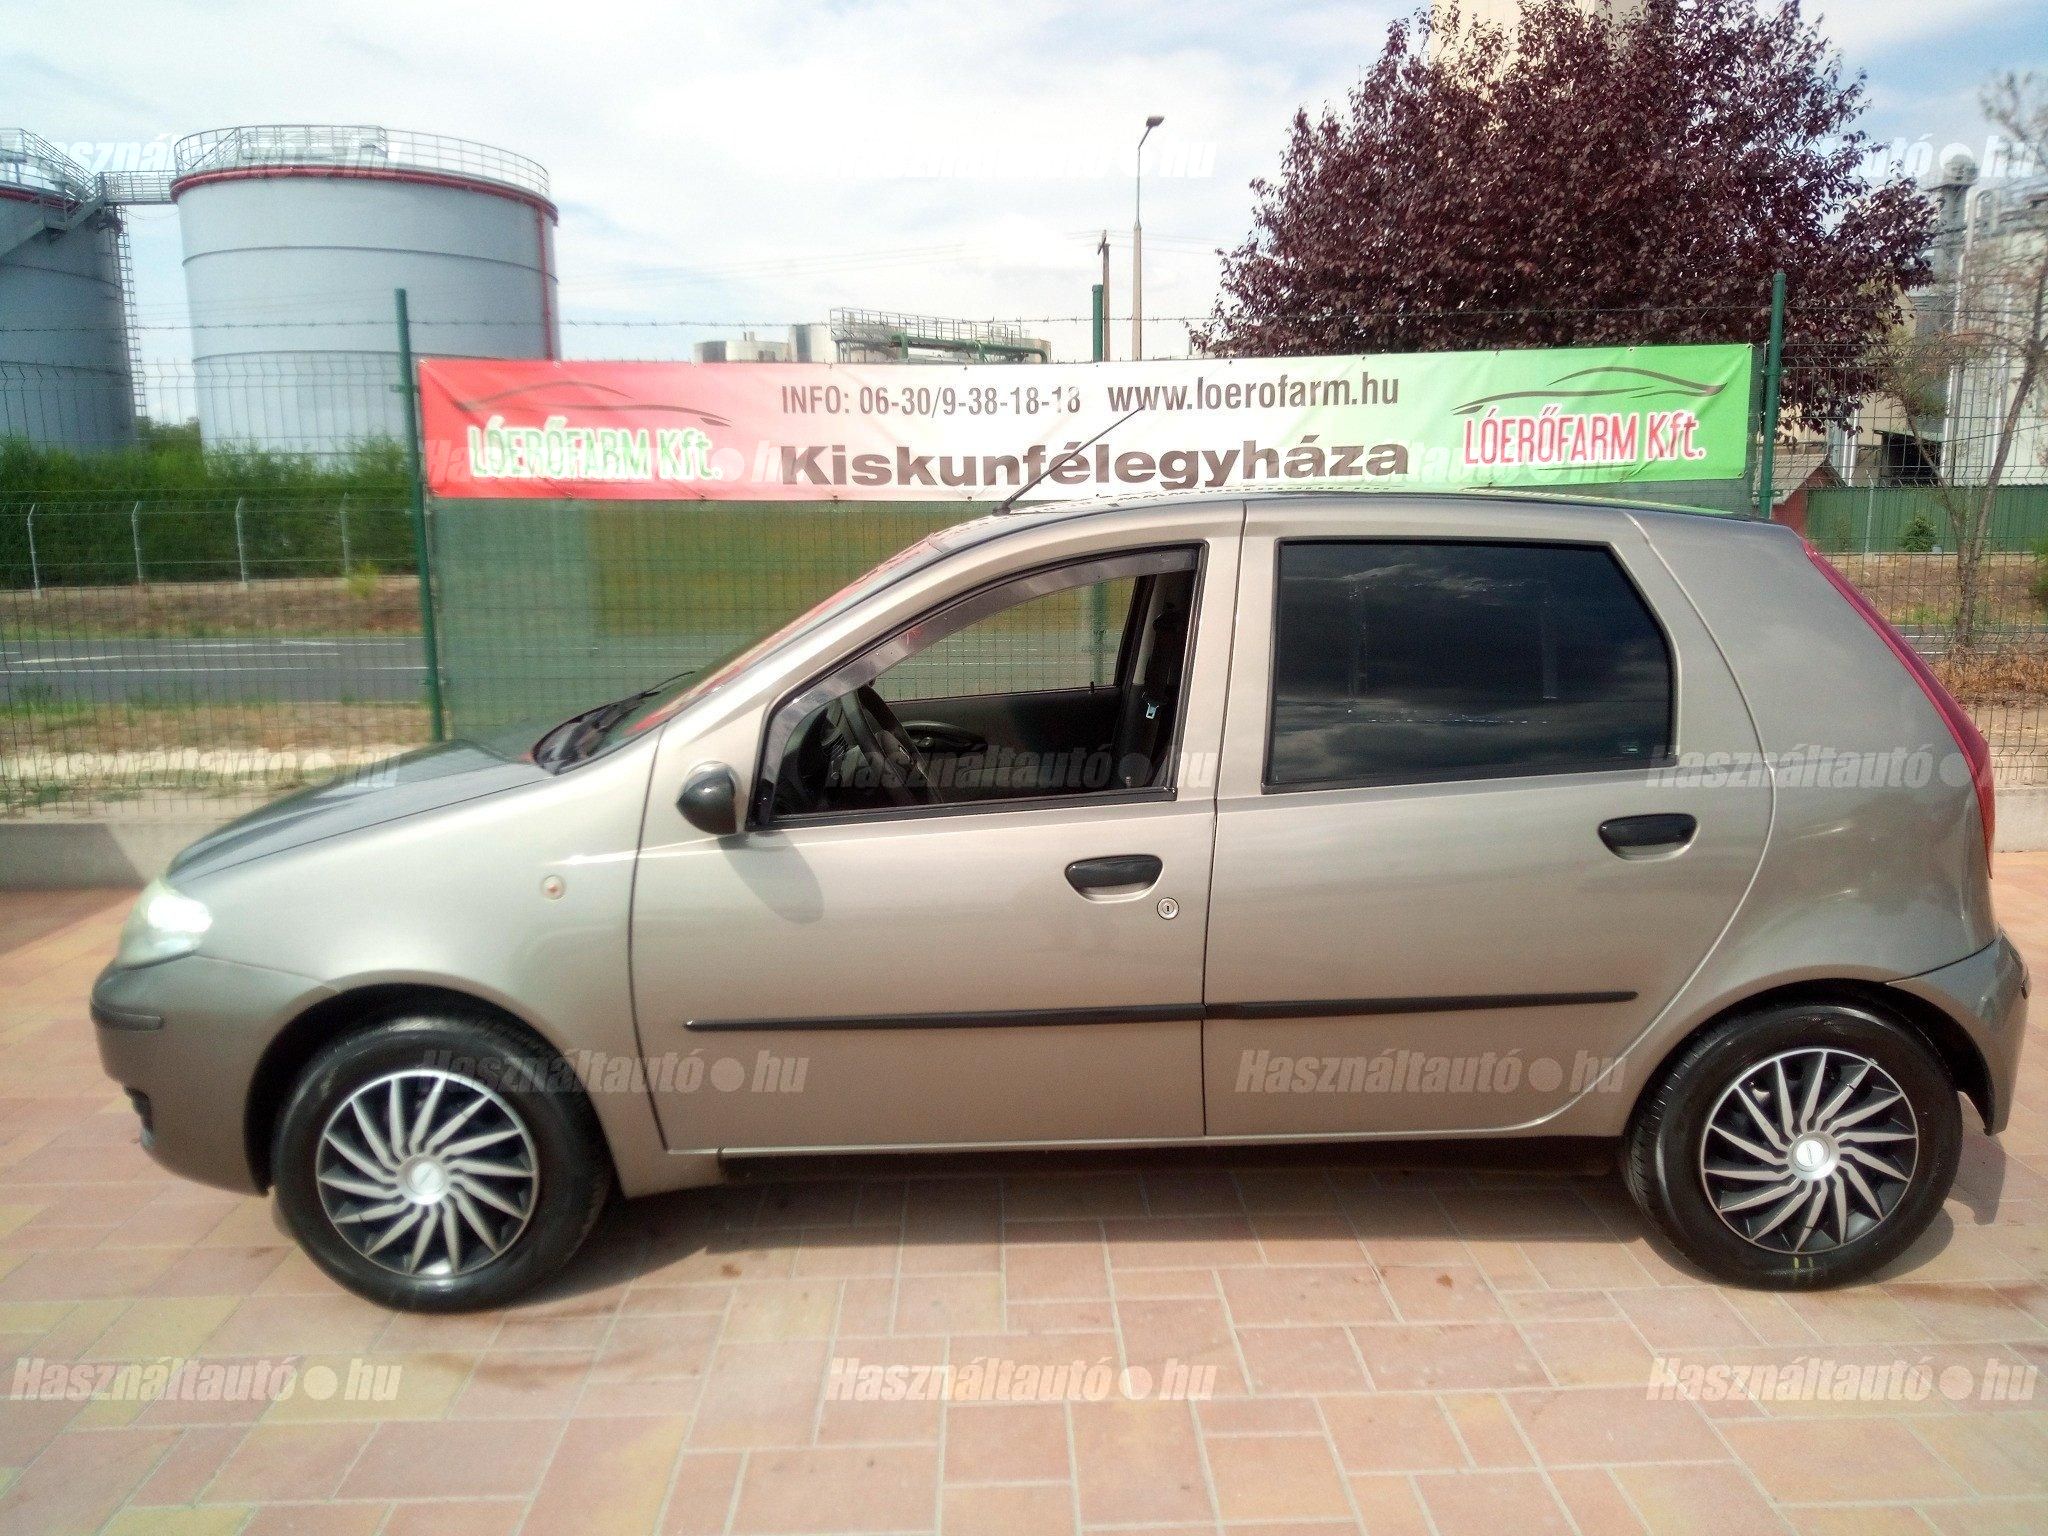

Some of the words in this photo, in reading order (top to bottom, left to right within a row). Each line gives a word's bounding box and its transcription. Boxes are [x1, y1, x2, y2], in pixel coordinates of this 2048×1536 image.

[781, 384, 850, 415] INFO:
[858, 385, 1082, 418] 06-30/9-38-18-18
[1107, 371, 1399, 412] www.loerofarm.hu
[656, 424, 723, 480] Kft.
[780, 434, 1409, 490] Kiskunfélegyháza
[1463, 405, 1638, 466] LÓERŐFARM
[1647, 411, 1705, 460] Kft.
